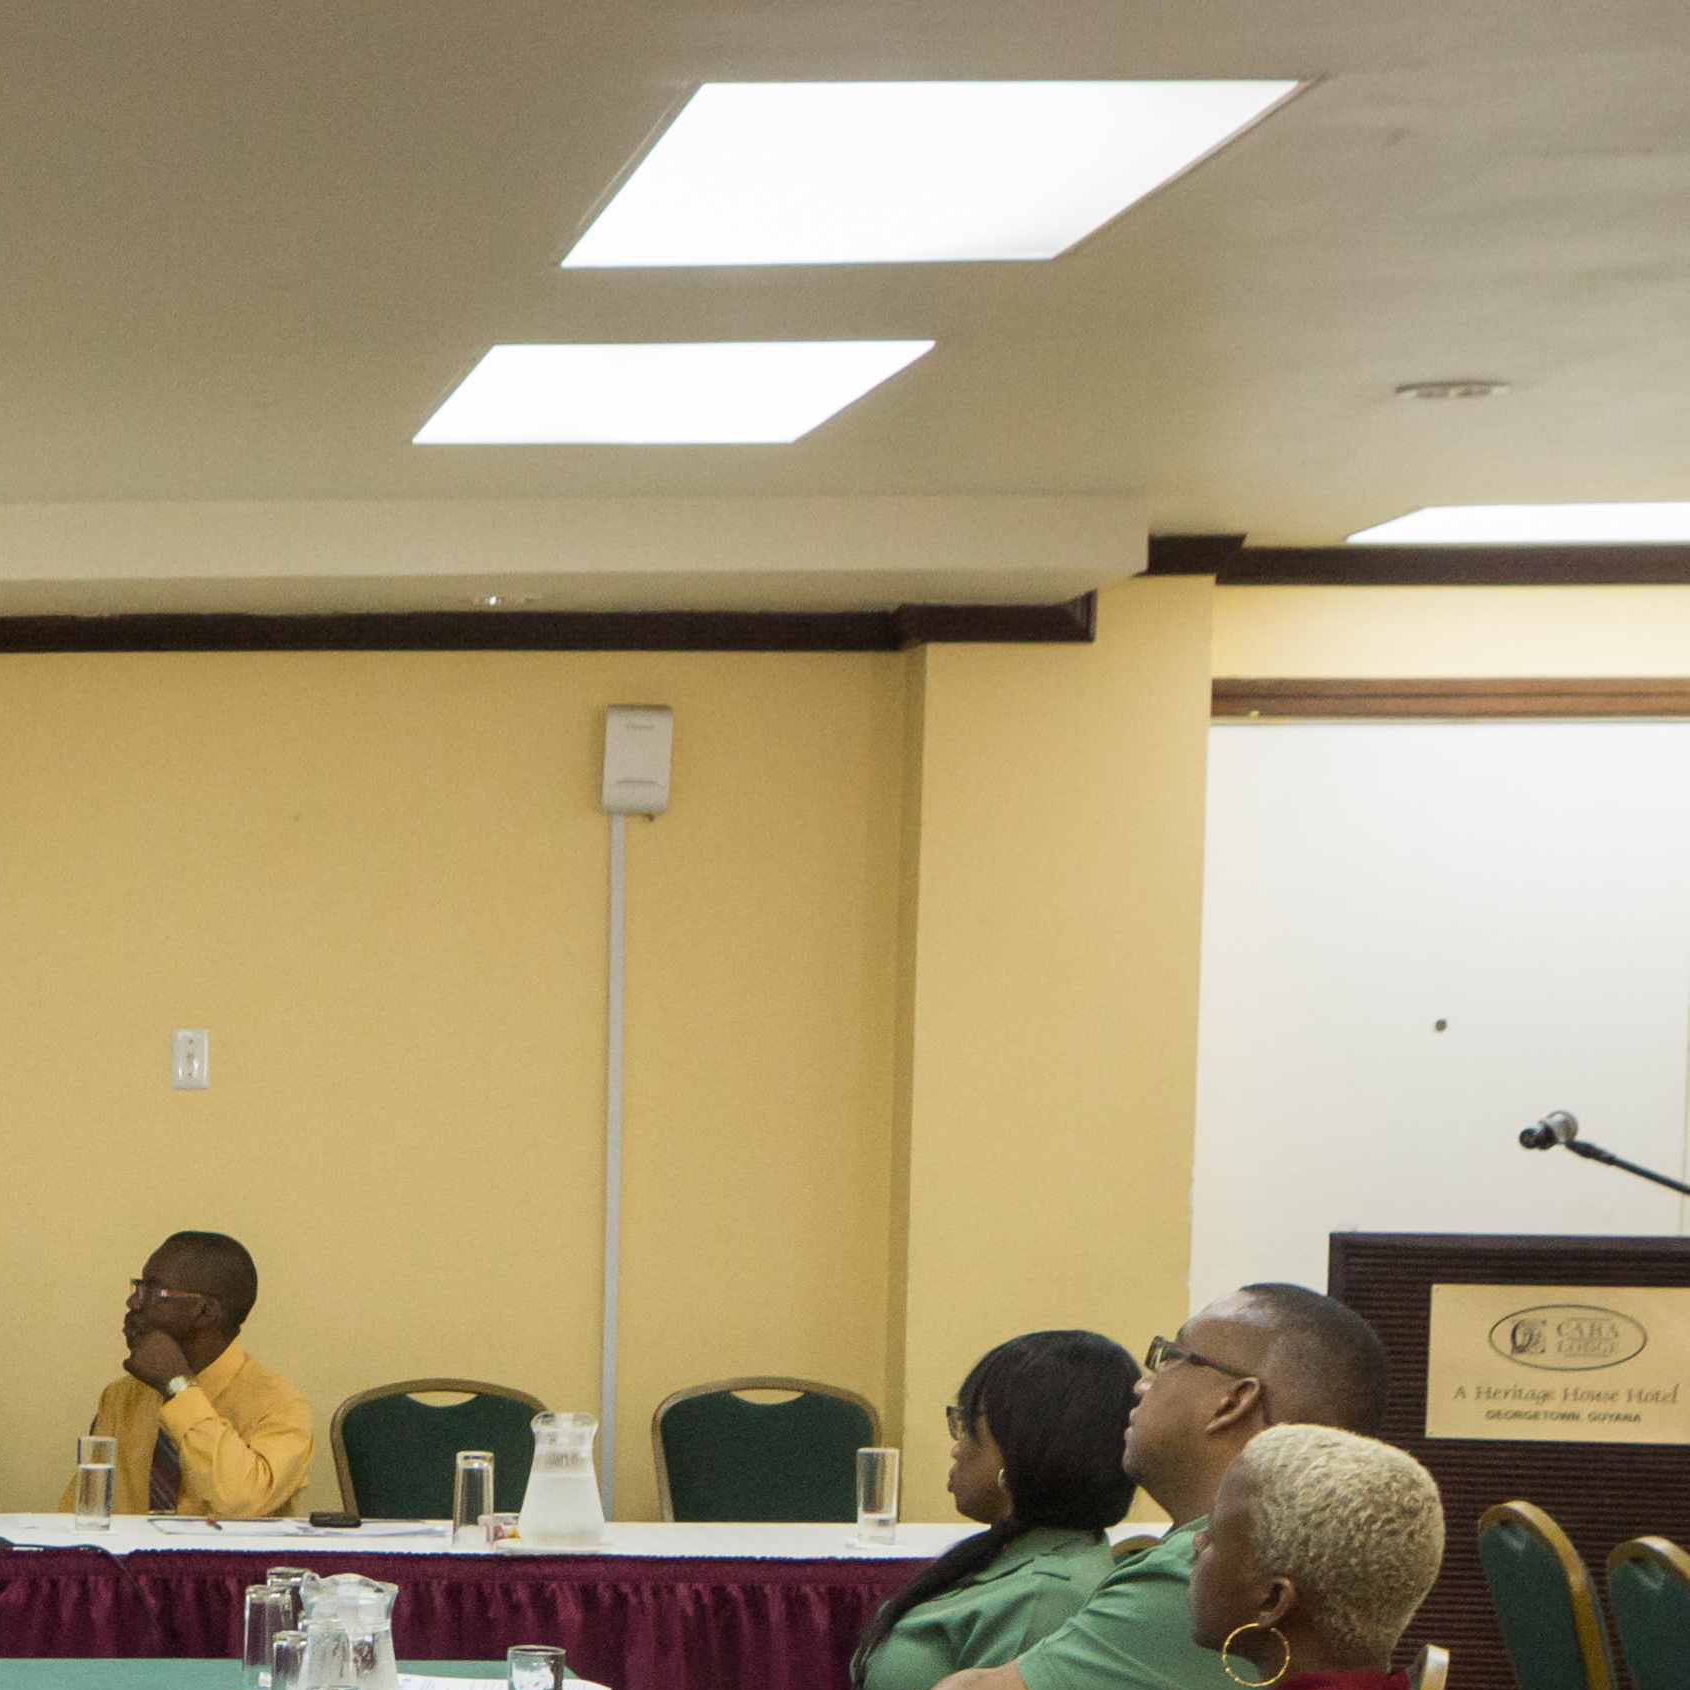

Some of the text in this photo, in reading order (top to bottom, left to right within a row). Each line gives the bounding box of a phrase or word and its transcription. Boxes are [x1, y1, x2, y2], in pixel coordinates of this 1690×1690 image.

[1453, 1383, 1680, 1405] A Heritage House Hotel
[1587, 1411, 1642, 1423] GUYANA
